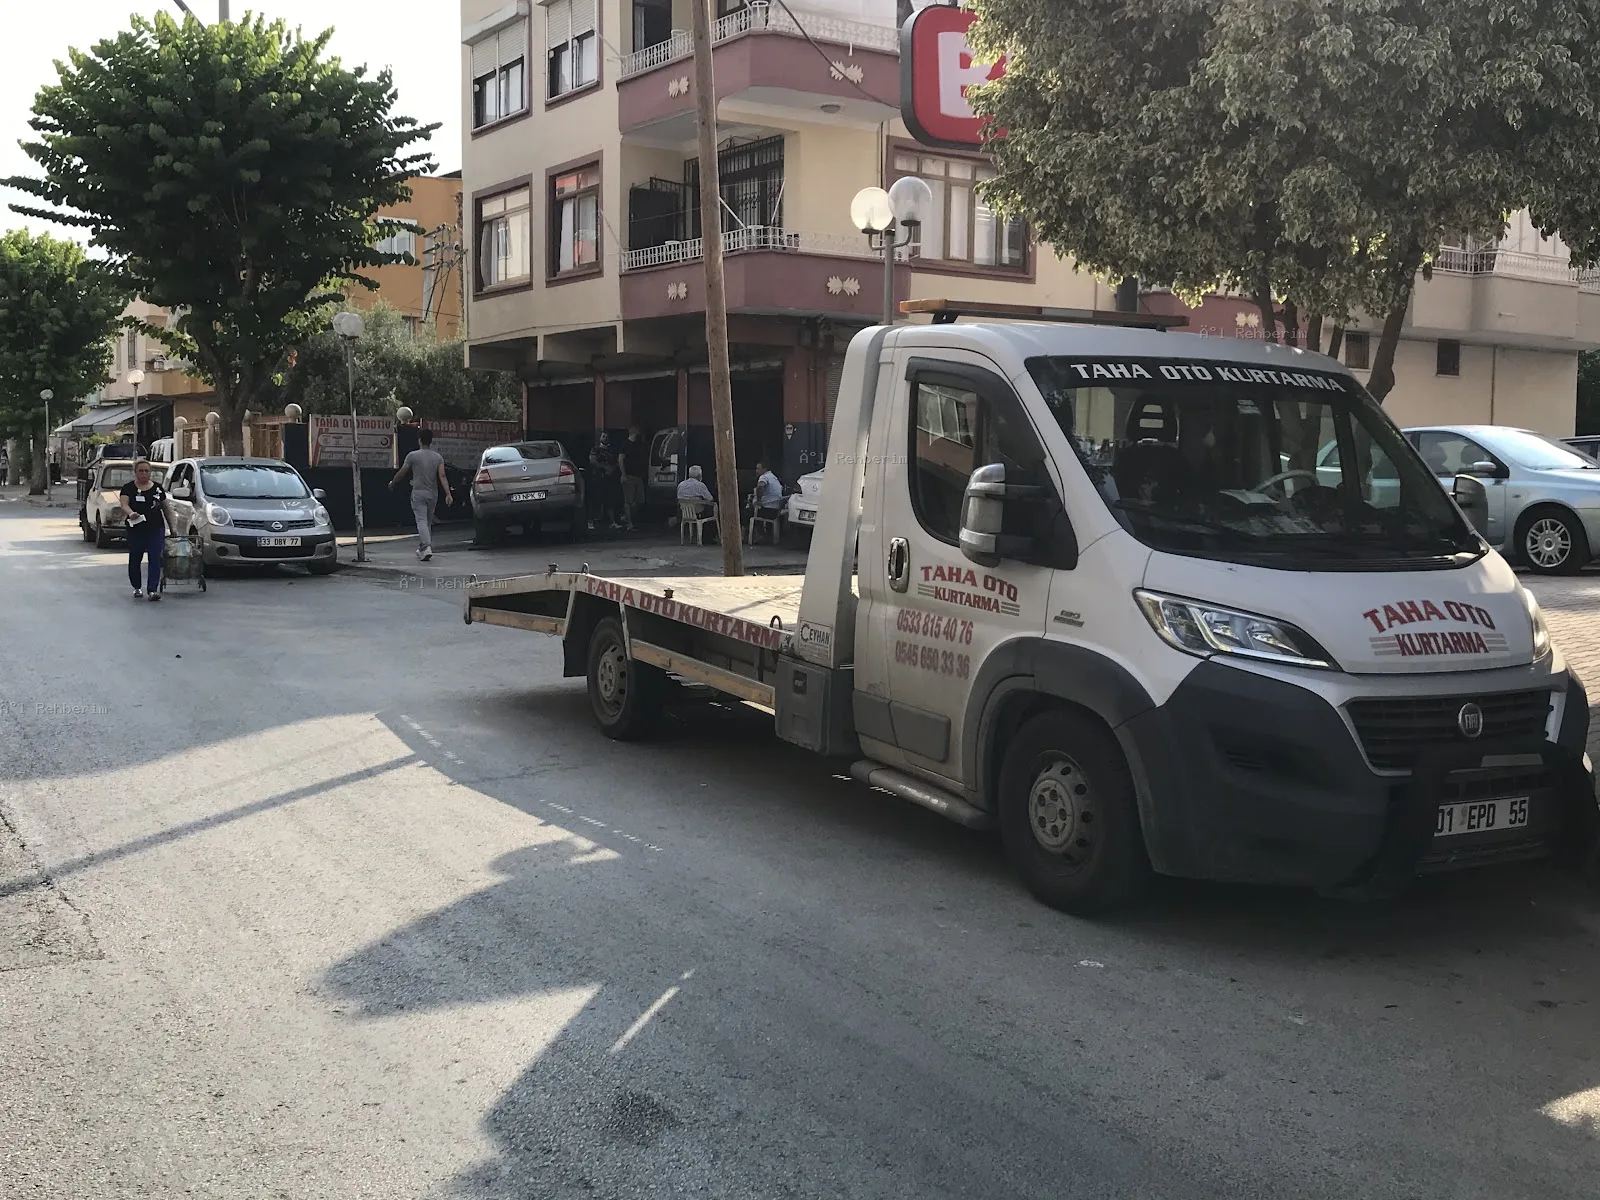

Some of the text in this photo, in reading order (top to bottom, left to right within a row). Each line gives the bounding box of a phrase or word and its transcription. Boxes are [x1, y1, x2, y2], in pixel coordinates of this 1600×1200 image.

[1070, 363, 1347, 392] TAHA OTO KURTARMA
[314, 417, 339, 428] TAHA
[427, 420, 457, 432] TAHA
[261, 537, 271, 547] 33
[290, 537, 299, 547] 77
[586, 577, 635, 606] TAHA
[639, 593, 675, 618] OTO
[920, 565, 1018, 602] TAHA OTO
[934, 585, 1000, 613] KURTARMA
[896, 608, 973, 645] 0533 815 40 76
[1363, 600, 1496, 633] TAHA OTO
[801, 623, 830, 646] CEYHAN
[1395, 631, 1489, 656] KURTARMA
[895, 640, 918, 667] 0545
[941, 650, 954, 675] 33
[1437, 799, 1527, 834] 01 EPD 55
